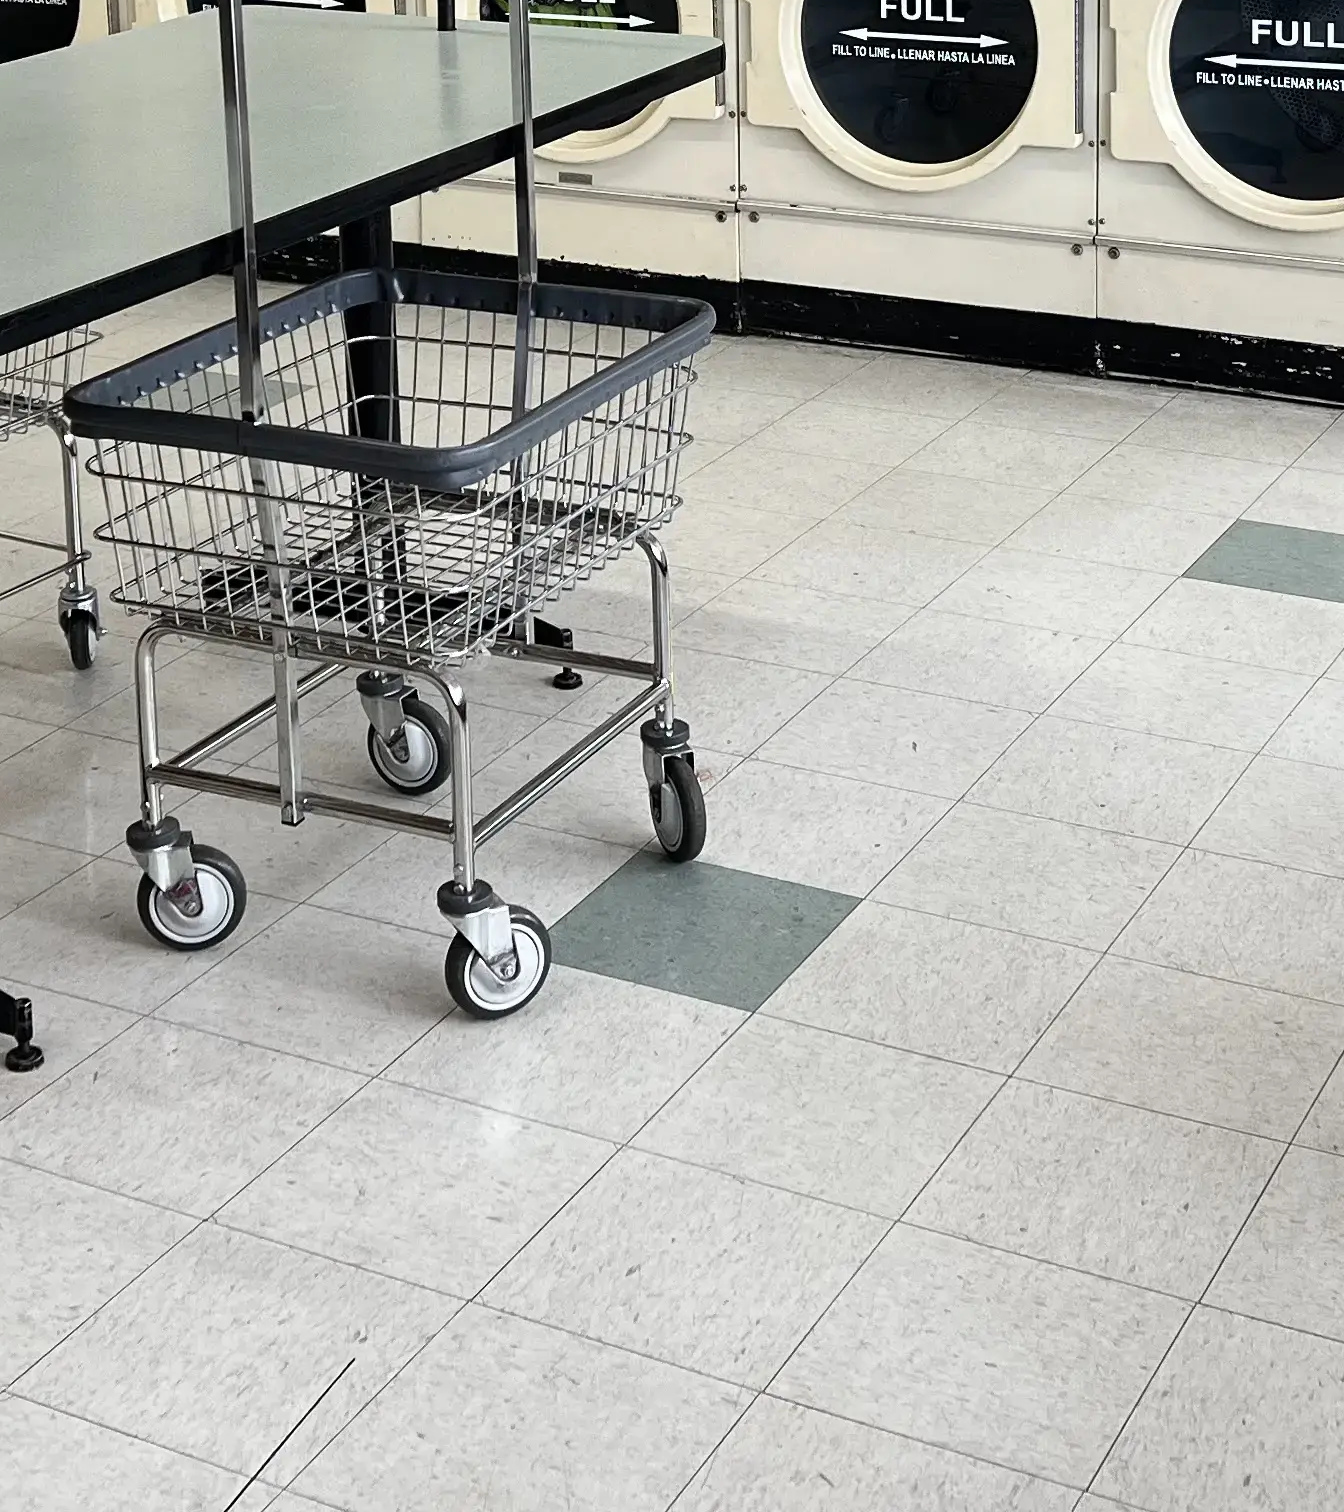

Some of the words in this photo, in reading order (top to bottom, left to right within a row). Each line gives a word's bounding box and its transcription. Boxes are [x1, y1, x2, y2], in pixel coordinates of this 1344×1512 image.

[832, 45, 852, 55] FILL
[853, 46, 866, 56] TO
[937, 51, 969, 62] HASTA
[971, 53, 984, 63] LA
[986, 54, 1015, 65] LINEA
[1196, 72, 1218, 84] FILL
[1220, 74, 1235, 85] TO
